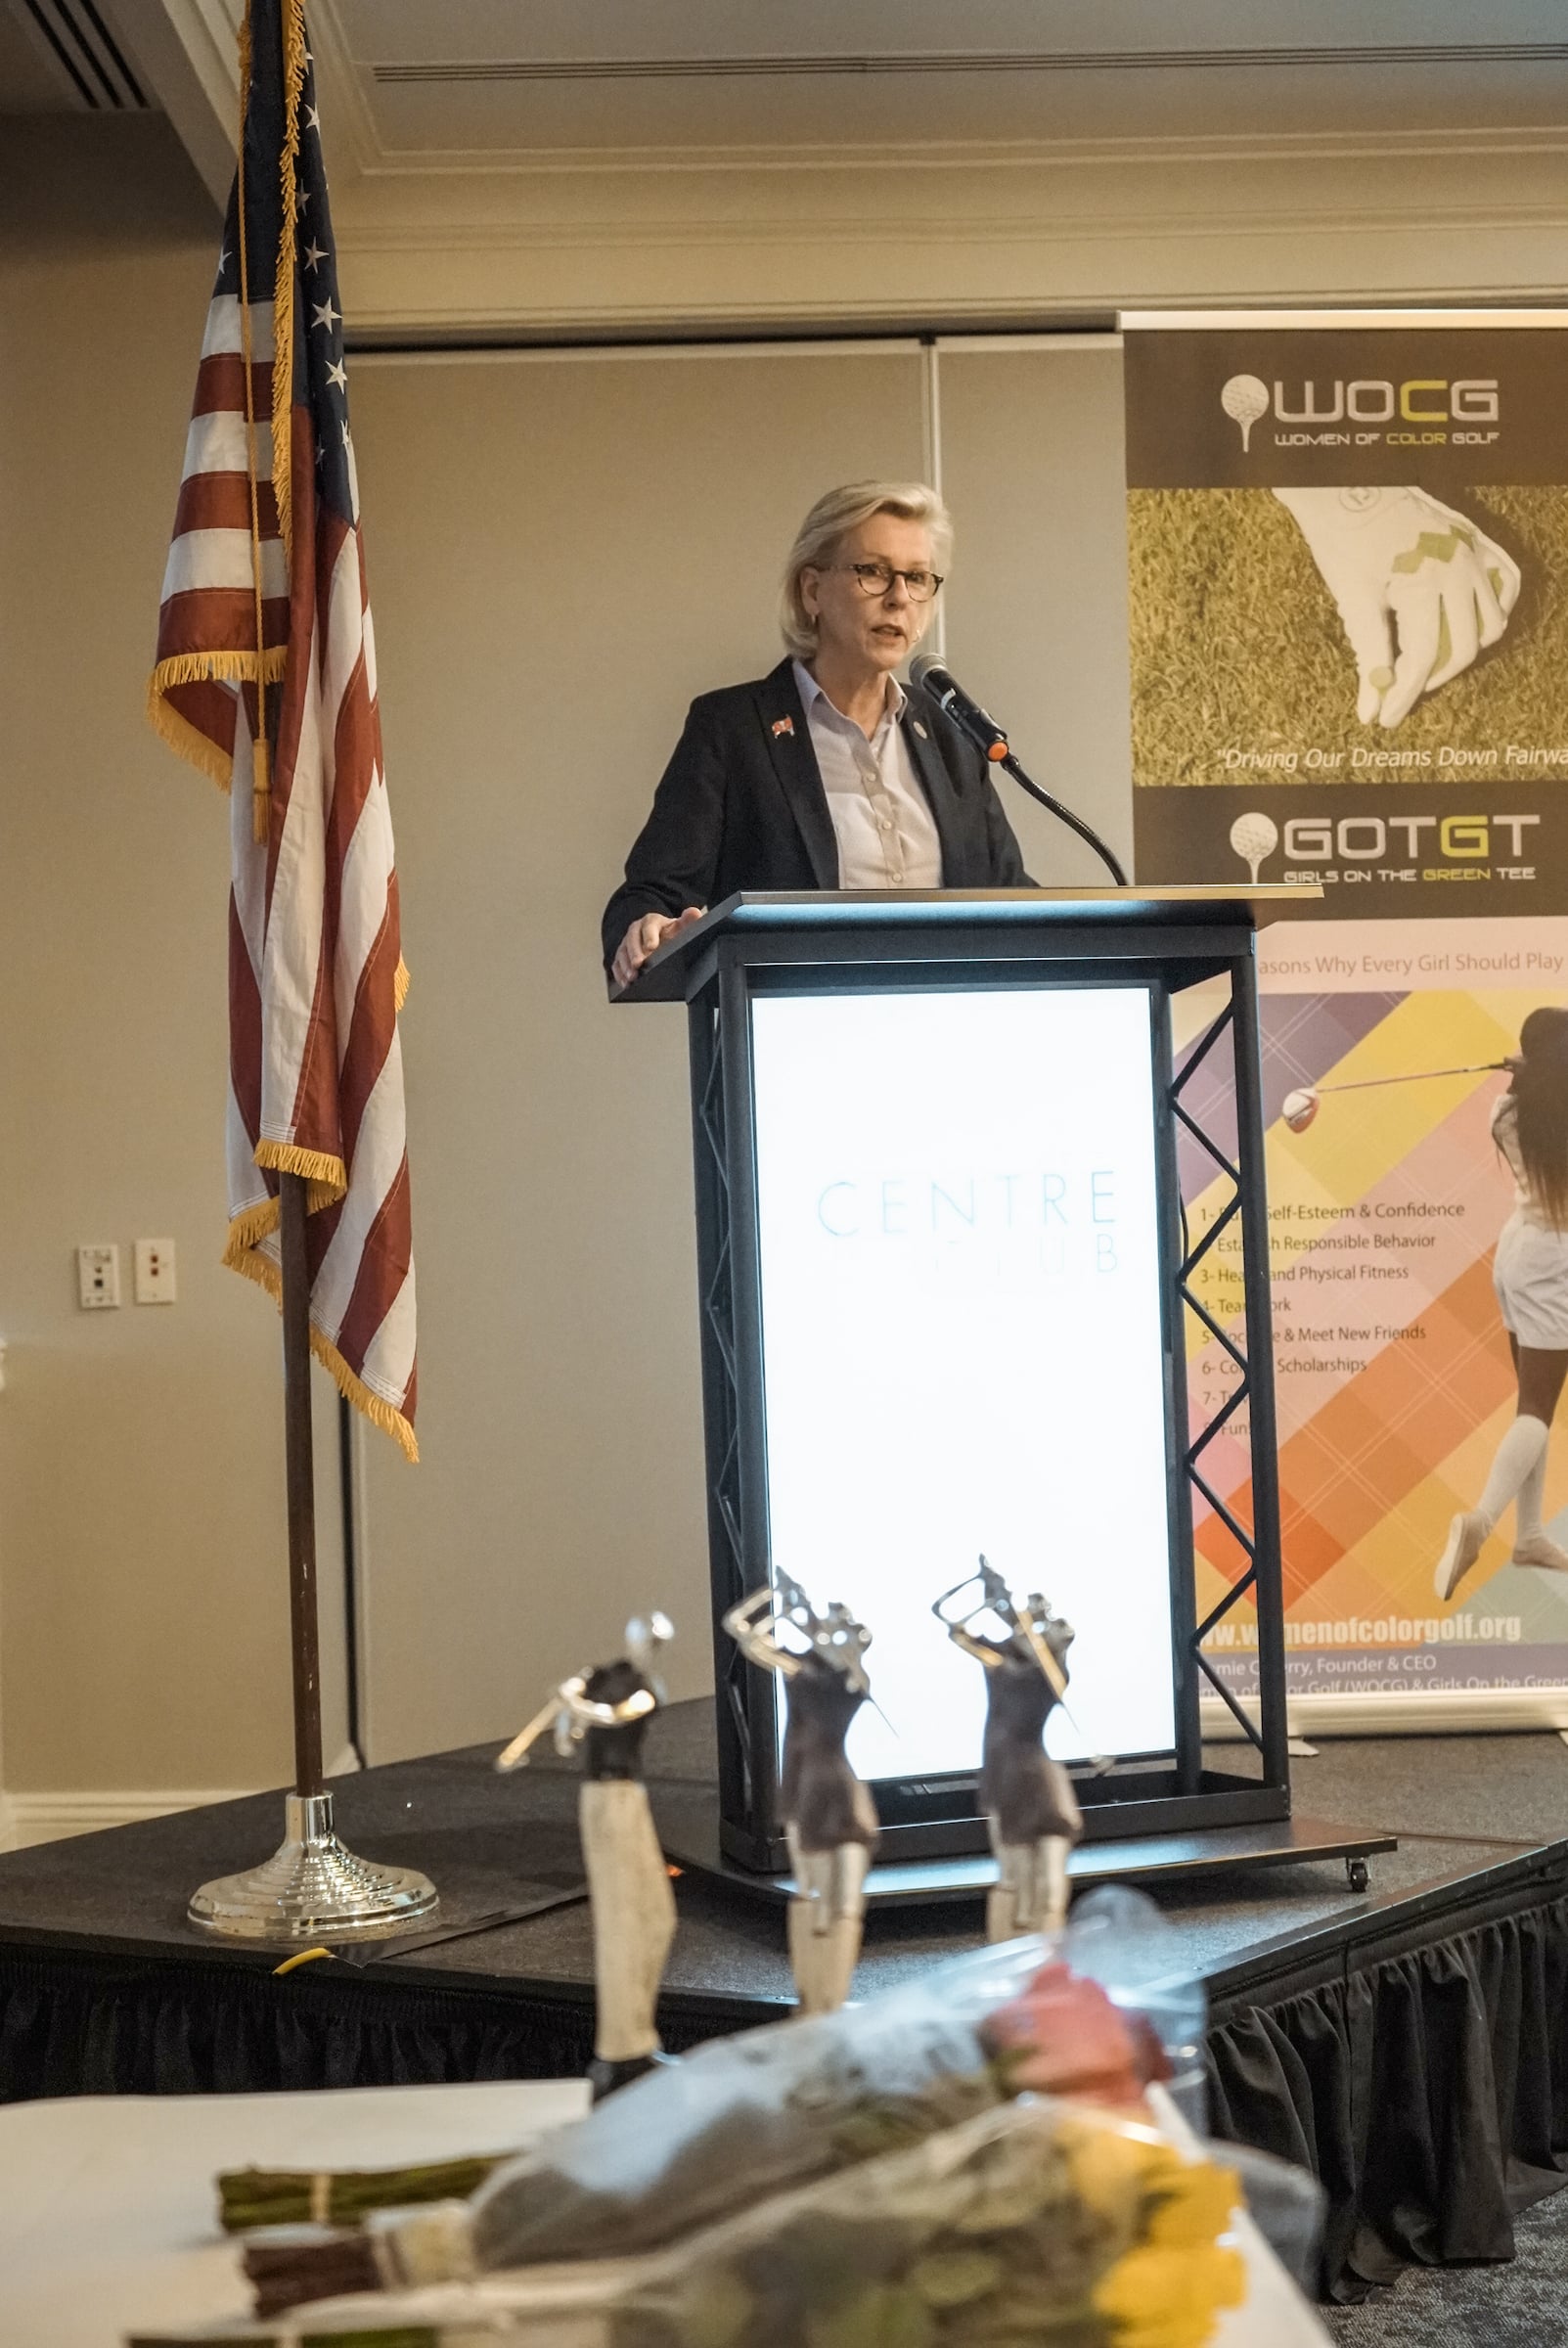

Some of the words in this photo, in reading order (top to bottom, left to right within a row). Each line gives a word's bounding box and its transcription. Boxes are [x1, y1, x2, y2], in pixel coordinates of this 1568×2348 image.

[1275, 380, 1499, 423] WOCG
[1275, 433, 1351, 445] WOMEN
[1355, 432, 1381, 444] OF
[1386, 432, 1448, 444] COLOR
[1452, 431, 1501, 444] GOLF
[1304, 748, 1345, 768] Our
[1352, 747, 1432, 767] Dreams
[1438, 745, 1498, 766] Down
[1504, 745, 1568, 765] Fairwa
[1284, 815, 1541, 860] GOTGT
[1283, 870, 1339, 883] GIRLS
[1344, 870, 1371, 882] ON
[1377, 869, 1417, 881] THE
[1422, 868, 1492, 880] GREEN
[1496, 867, 1537, 880] TEE
[1259, 960, 1312, 974] asons
[1315, 956, 1357, 977] Why
[1363, 955, 1412, 976] Every
[1418, 954, 1450, 971] Girl
[1456, 952, 1521, 971] Should
[1526, 951, 1564, 974] Play
[818, 1171, 1116, 1238] CENTRE
[1359, 1204, 1370, 1218] &
[1375, 1202, 1465, 1218] Confidence
[1284, 1235, 1369, 1252] Responsible
[1374, 1234, 1436, 1249] Behavior
[1300, 1265, 1356, 1287] Physical
[1361, 1264, 1410, 1280] Fitness
[1284, 1328, 1295, 1342] &
[1299, 1327, 1334, 1341] Meet
[1338, 1327, 1370, 1340] New
[1375, 1325, 1426, 1340] Friends
[1277, 1356, 1367, 1375] Scholarships
[1318, 1657, 1383, 1673] Founder
[1387, 1656, 1399, 1671] &
[1403, 1654, 1437, 1671] CEO
